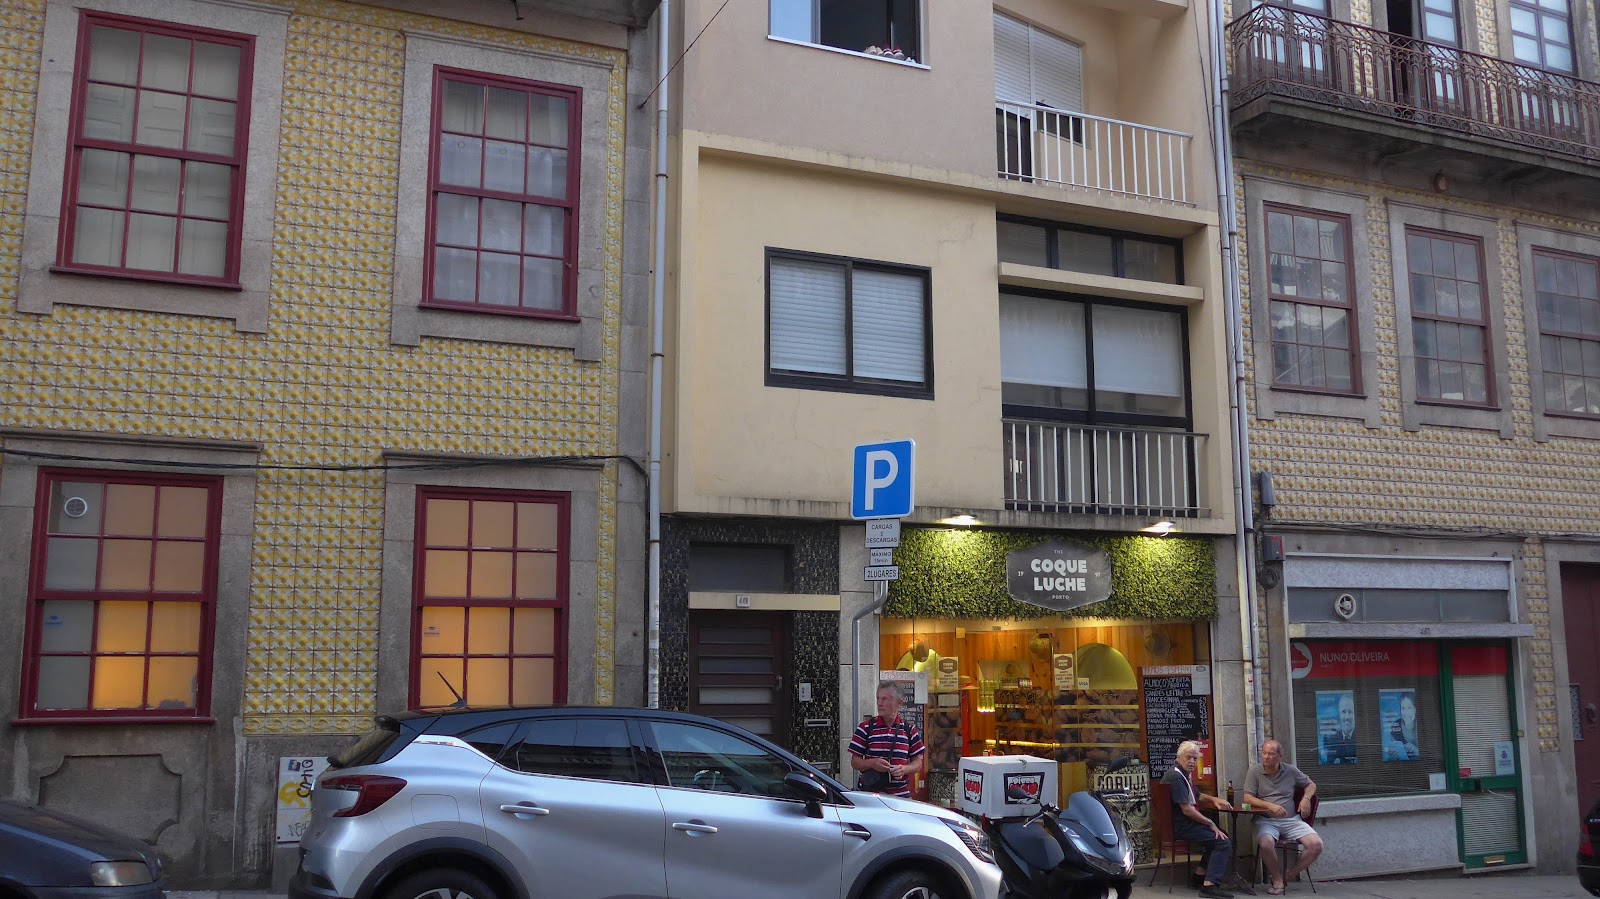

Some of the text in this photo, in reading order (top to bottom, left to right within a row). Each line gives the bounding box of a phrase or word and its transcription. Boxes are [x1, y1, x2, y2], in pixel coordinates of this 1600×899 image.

[864, 449, 899, 511] P
[1030, 558, 1088, 577] COQUE
[1033, 577, 1087, 592] LUCHE
[1320, 651, 1390, 663] NUNO OLIVEIRA
